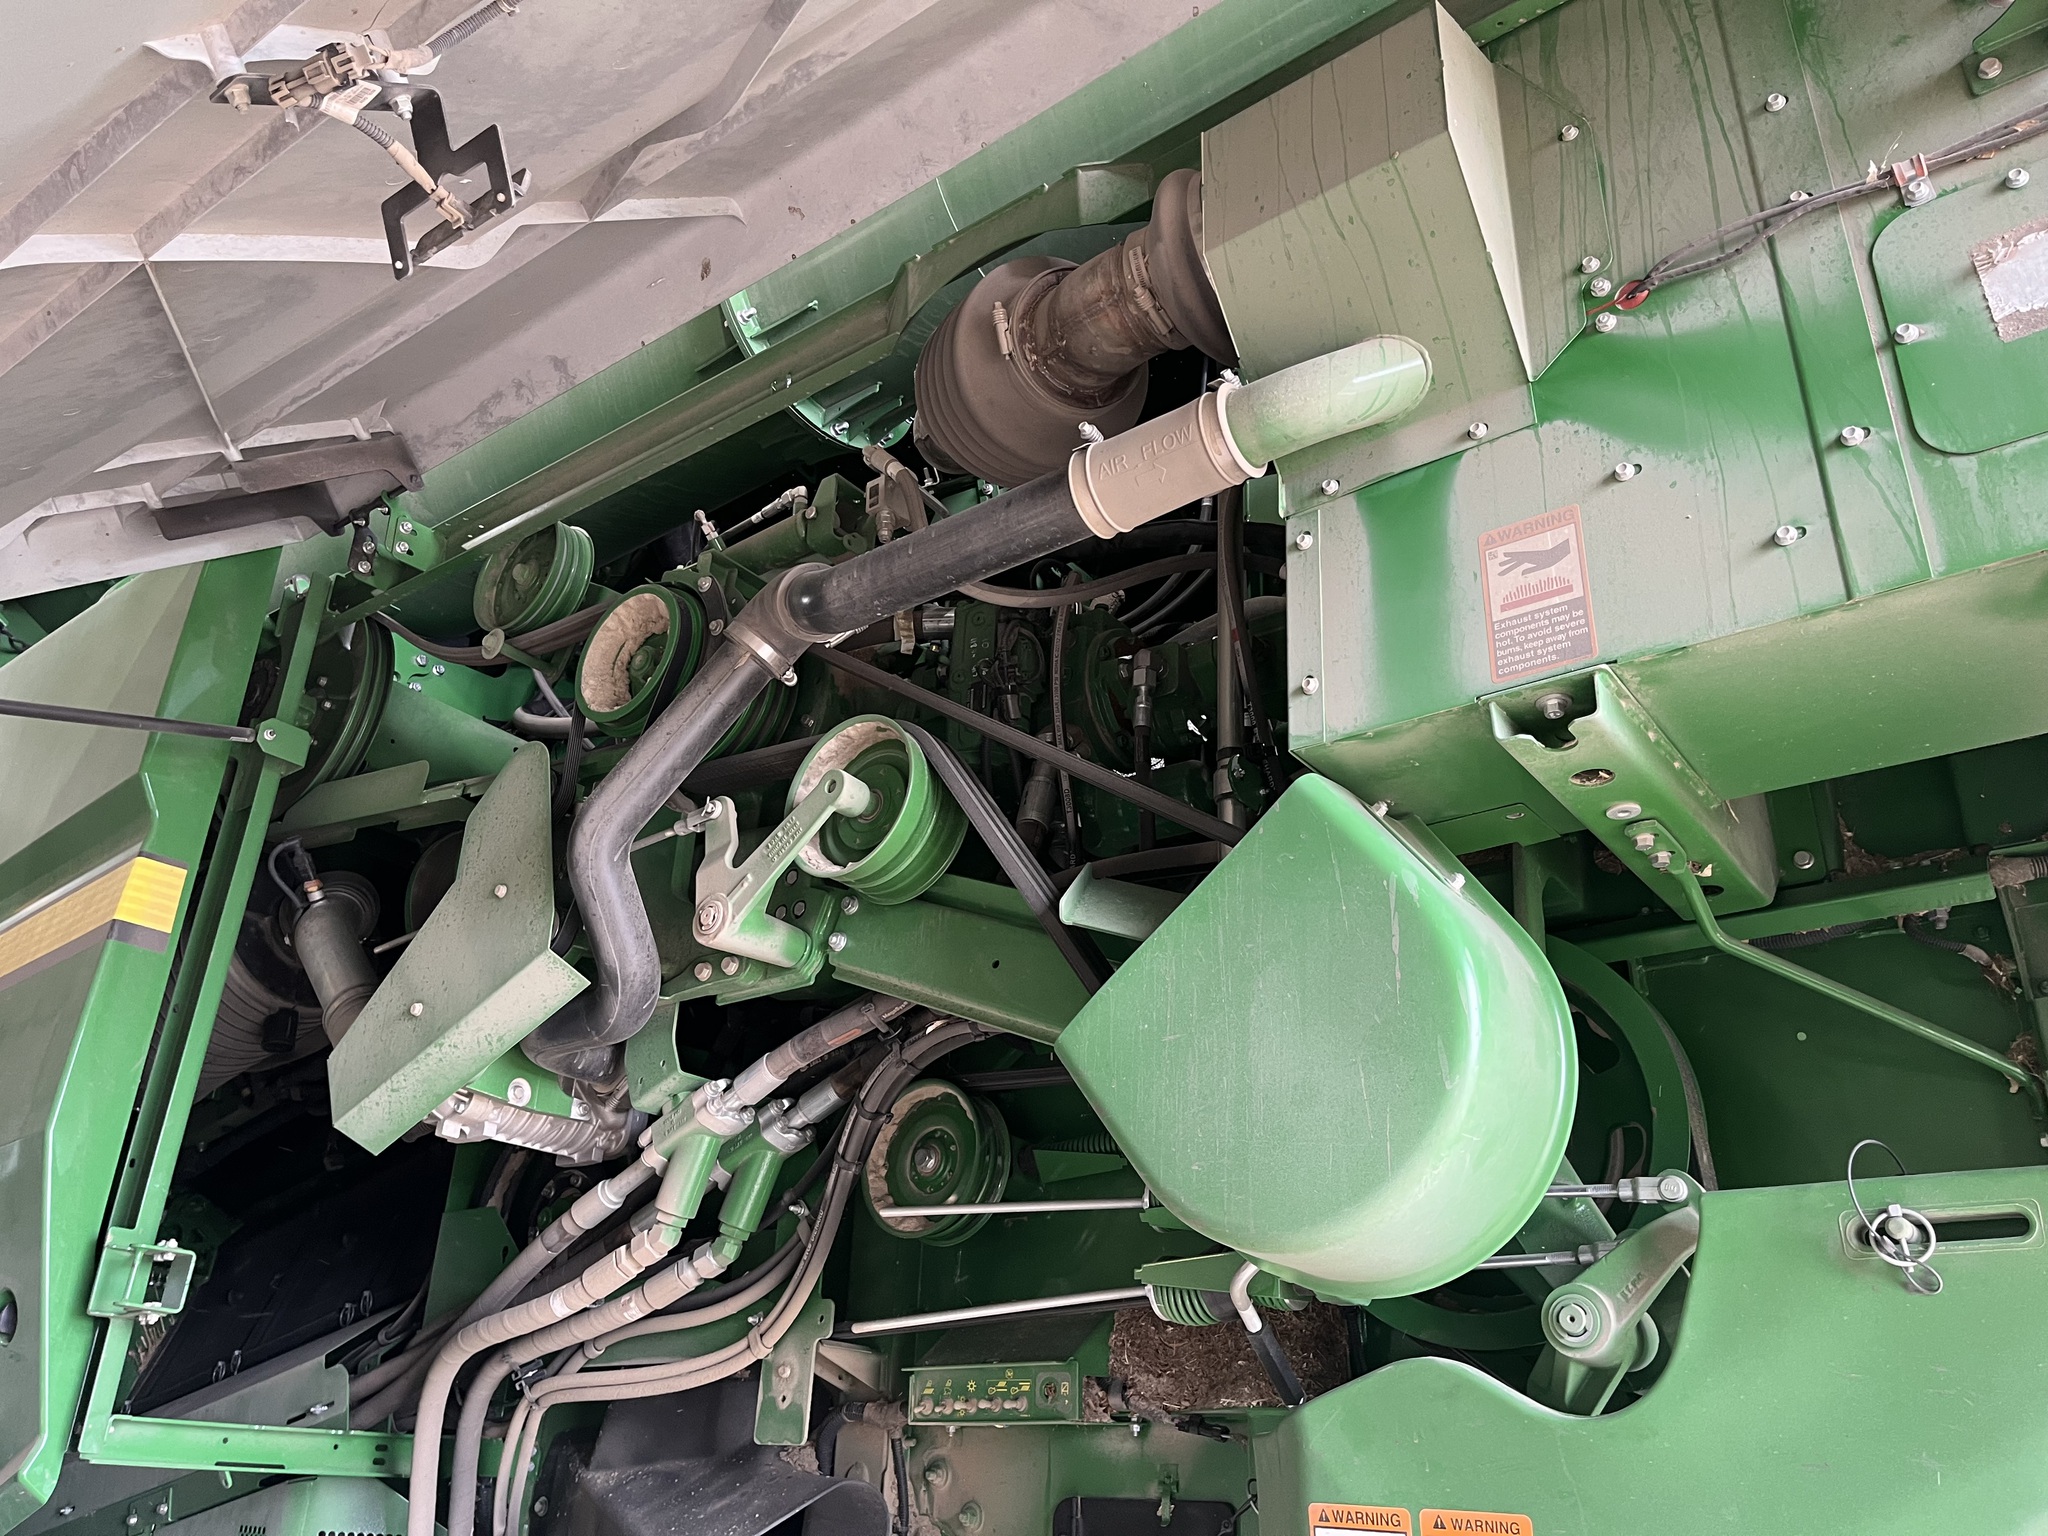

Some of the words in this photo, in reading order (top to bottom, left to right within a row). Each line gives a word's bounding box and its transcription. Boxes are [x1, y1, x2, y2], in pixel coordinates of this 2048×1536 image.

[1099, 454, 1129, 481] AIR
[1141, 423, 1193, 461] FLOW
[1497, 509, 1575, 543] WARNING
[1494, 614, 1531, 630] Exhaust
[1535, 604, 1568, 620] system
[1495, 619, 1549, 639] components
[1552, 614, 1570, 626] may
[1573, 609, 1583, 619] be
[1496, 639, 1513, 648] hot.
[1514, 635, 1525, 643] To
[1527, 627, 1552, 640] avoid
[1555, 618, 1585, 632] severe
[1497, 645, 1522, 657] burns,
[1524, 639, 1543, 650] keep
[1546, 633, 1567, 644] away
[1569, 626, 1588, 638] from
[1497, 651, 1535, 665] exhaust
[1537, 641, 1571, 657] system
[1498, 654, 1559, 675] components.
[1332, 1510, 1401, 1527] WARNING
[1451, 1518, 1520, 1535] WARNING
